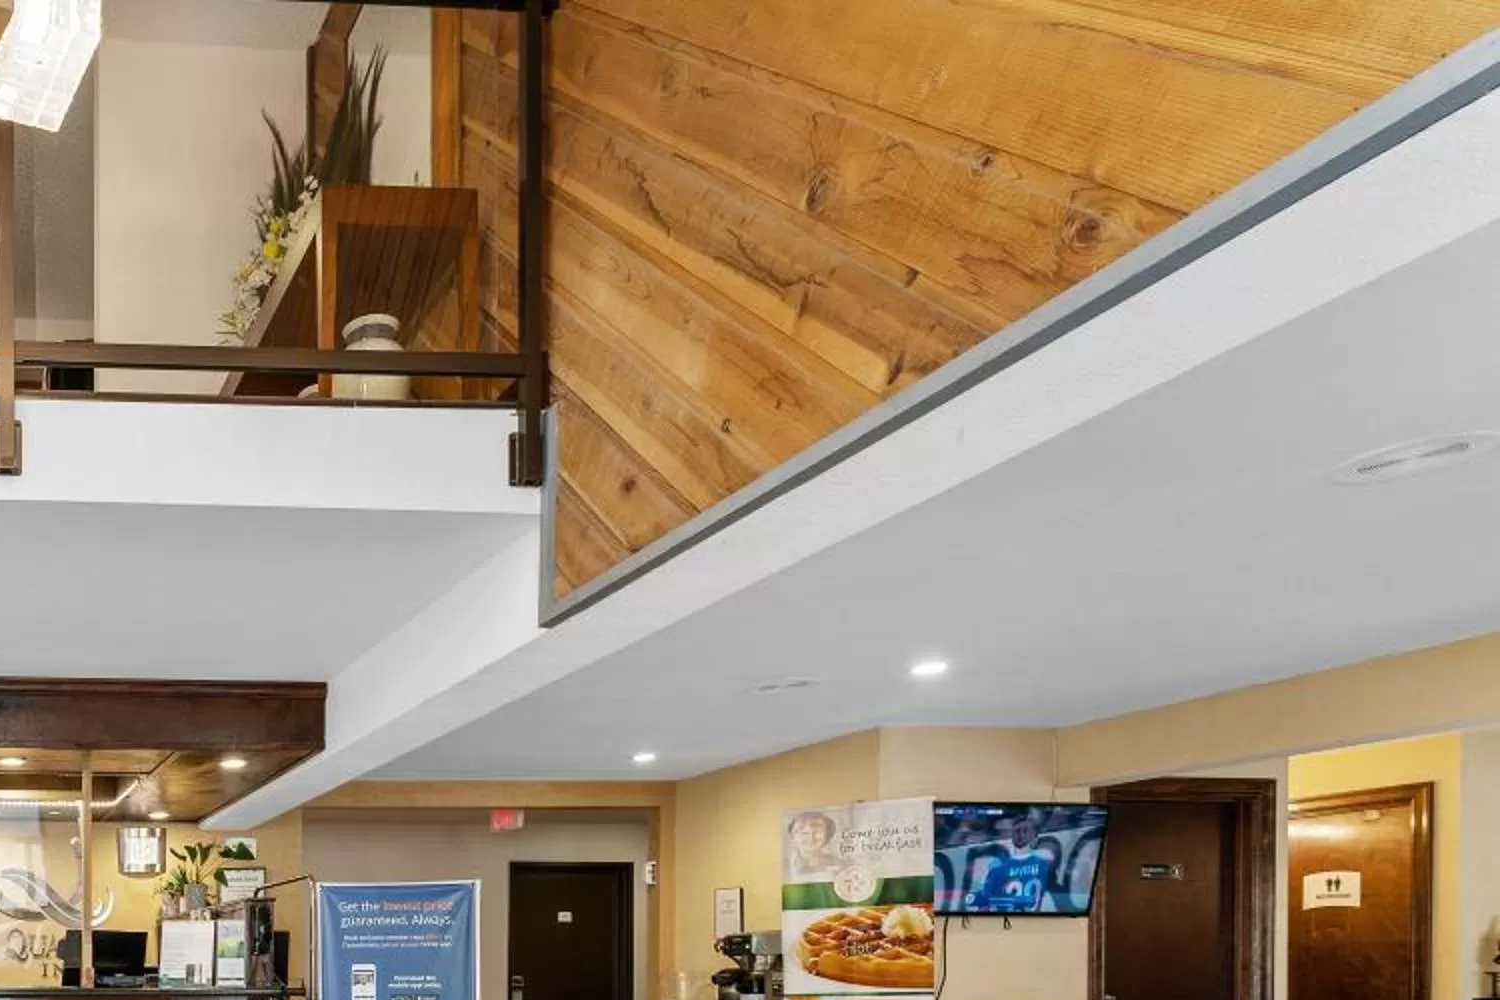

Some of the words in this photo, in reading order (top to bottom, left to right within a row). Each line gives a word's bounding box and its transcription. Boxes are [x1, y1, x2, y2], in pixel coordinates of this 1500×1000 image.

[339, 901, 360, 913] Get
[361, 900, 380, 911] the
[5, 928, 60, 962] QUA
